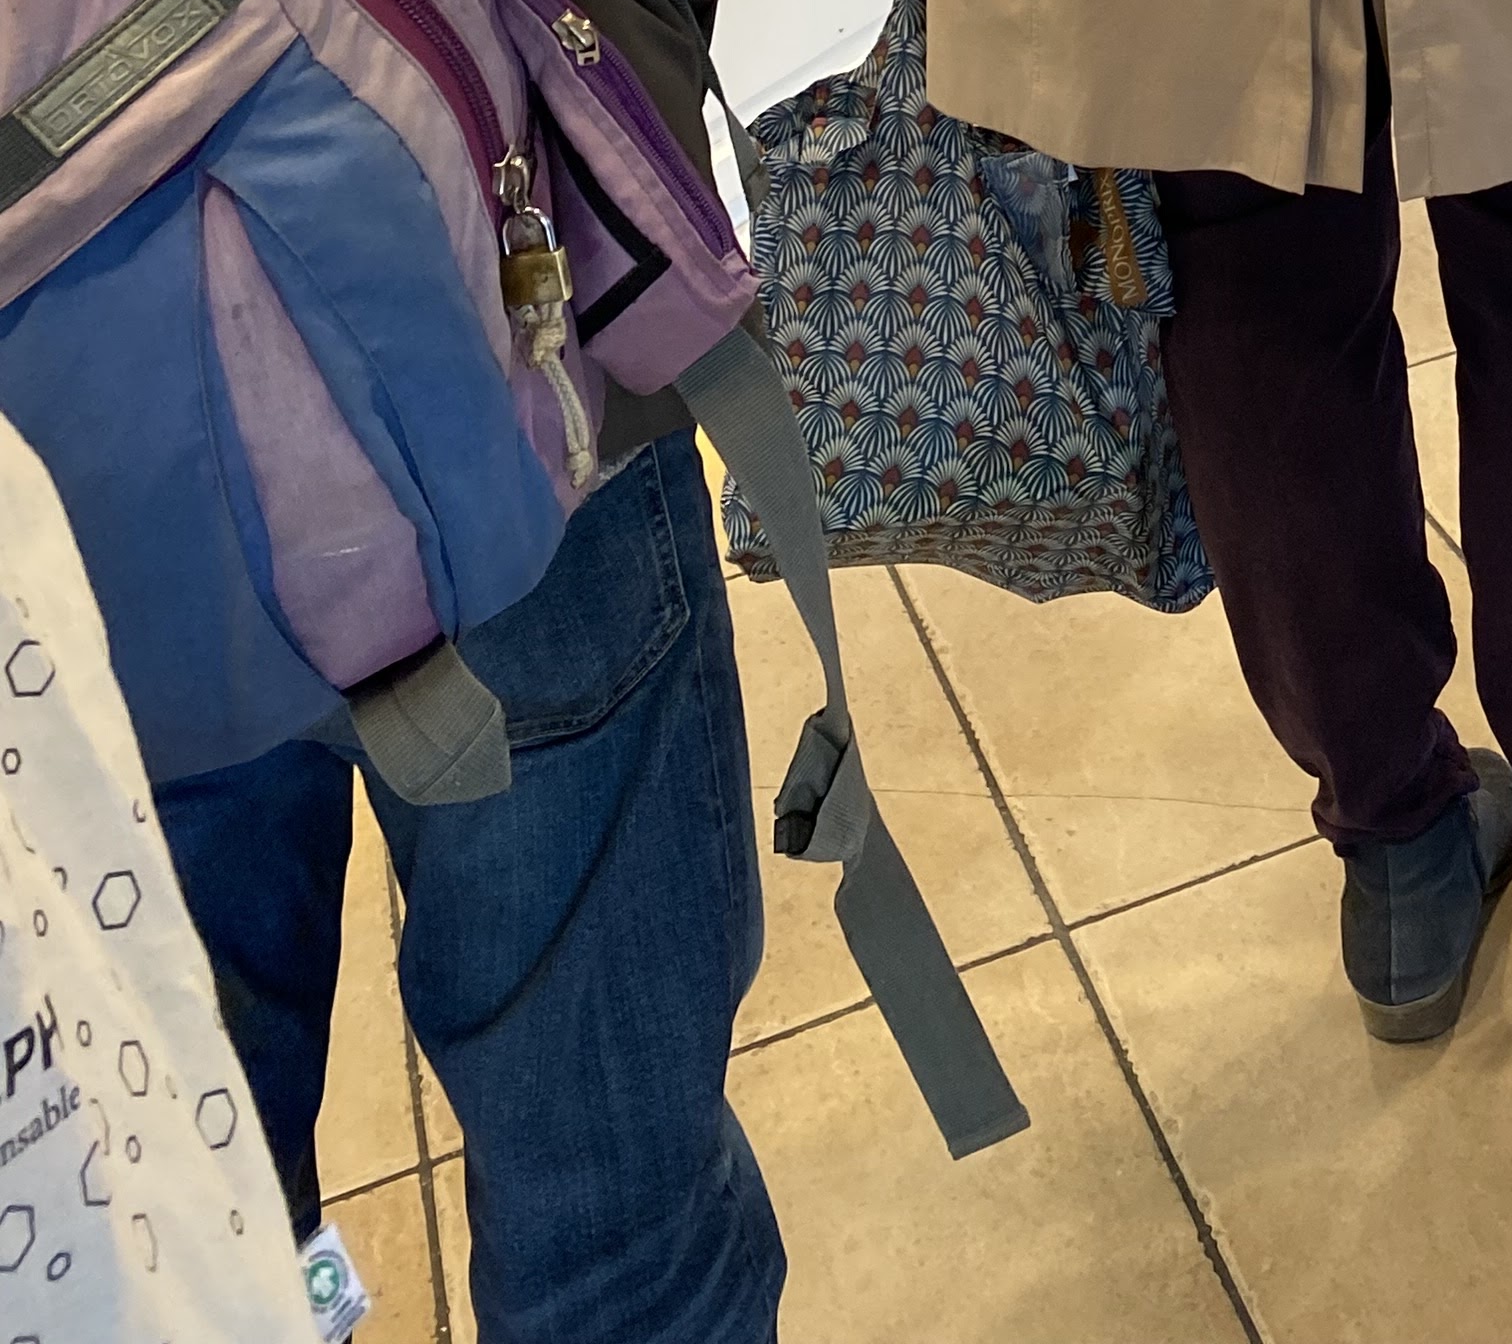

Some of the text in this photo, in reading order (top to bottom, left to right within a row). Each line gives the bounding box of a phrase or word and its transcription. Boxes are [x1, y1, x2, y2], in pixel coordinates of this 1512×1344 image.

[50, 0, 203, 132] ORTOVOX
[1100, 174, 1139, 304] MONOPRIX
[0, 993, 64, 1106] PH
